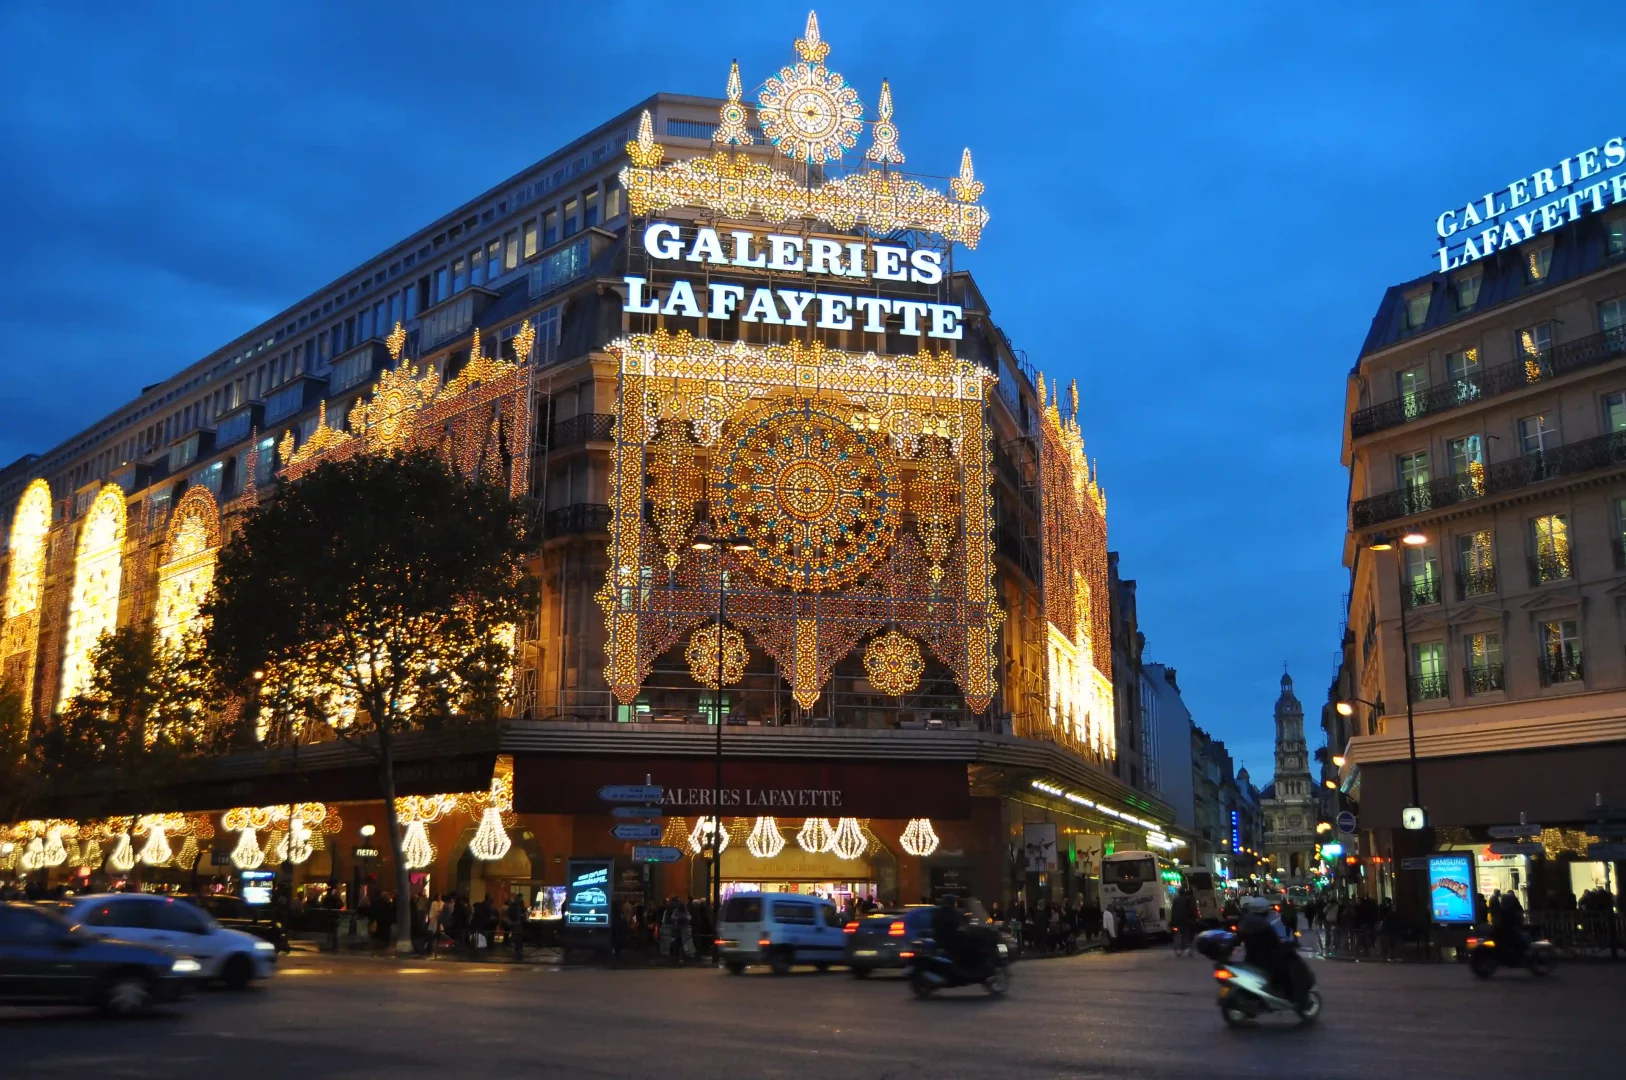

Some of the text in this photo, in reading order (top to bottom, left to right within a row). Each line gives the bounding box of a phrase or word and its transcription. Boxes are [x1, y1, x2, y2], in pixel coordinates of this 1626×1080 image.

[1436, 136, 1626, 238] GALERIES
[644, 223, 942, 285] GALERIES
[1437, 173, 1626, 273] LAFAYETTE
[623, 276, 963, 340] LAFAYETTE
[745, 789, 842, 806] LAFAYETTE
[1430, 858, 1467, 866] SAMSUNG
